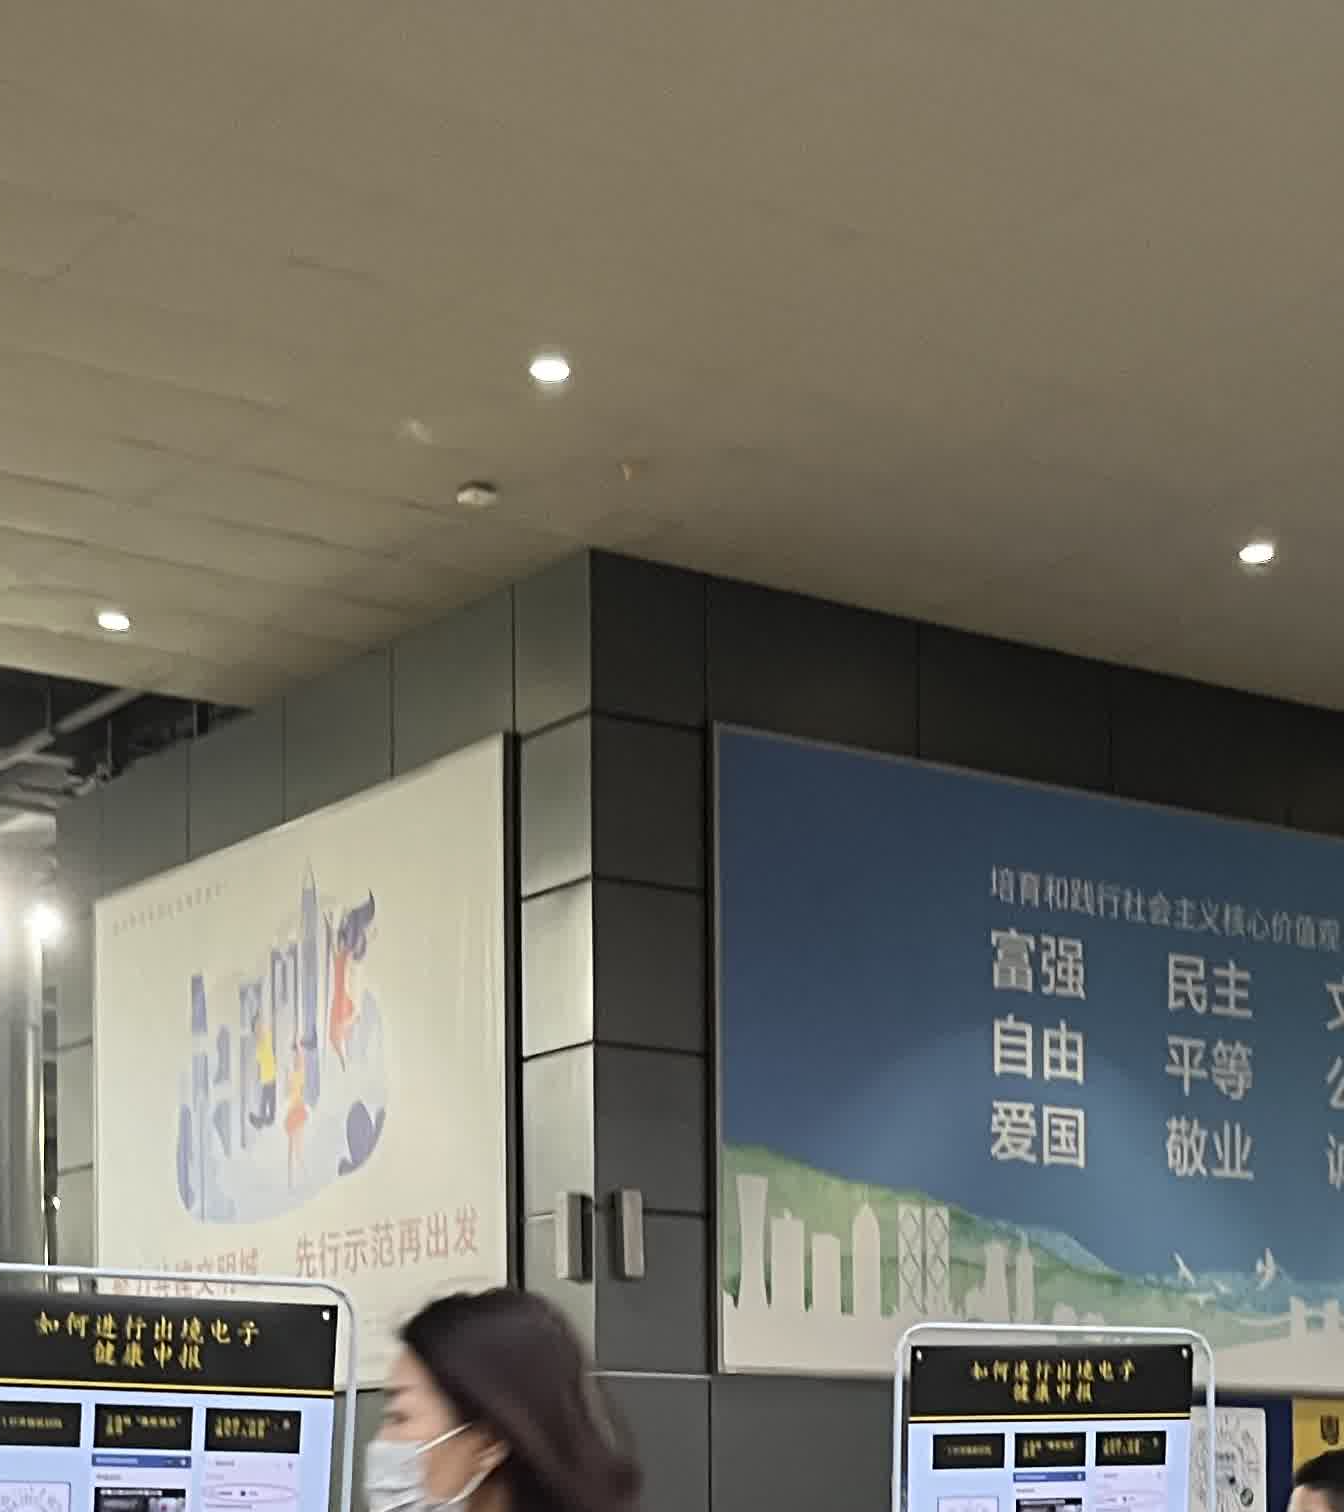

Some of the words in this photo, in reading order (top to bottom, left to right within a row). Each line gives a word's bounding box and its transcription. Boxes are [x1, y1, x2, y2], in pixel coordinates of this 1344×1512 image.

[991, 864, 1340, 952] 培育和践行社会主义核心价值观
[990, 928, 1086, 1000] 富强
[1167, 952, 1253, 1018] 民主
[992, 1013, 1085, 1085] 自由
[1165, 1035, 1253, 1100] 平等
[990, 1101, 1086, 1169] 爱国
[1165, 1116, 1255, 1180] 敬业
[295, 1203, 480, 1278] 先行示范再出发
[35, 1311, 260, 1345] 如何进行出境电子
